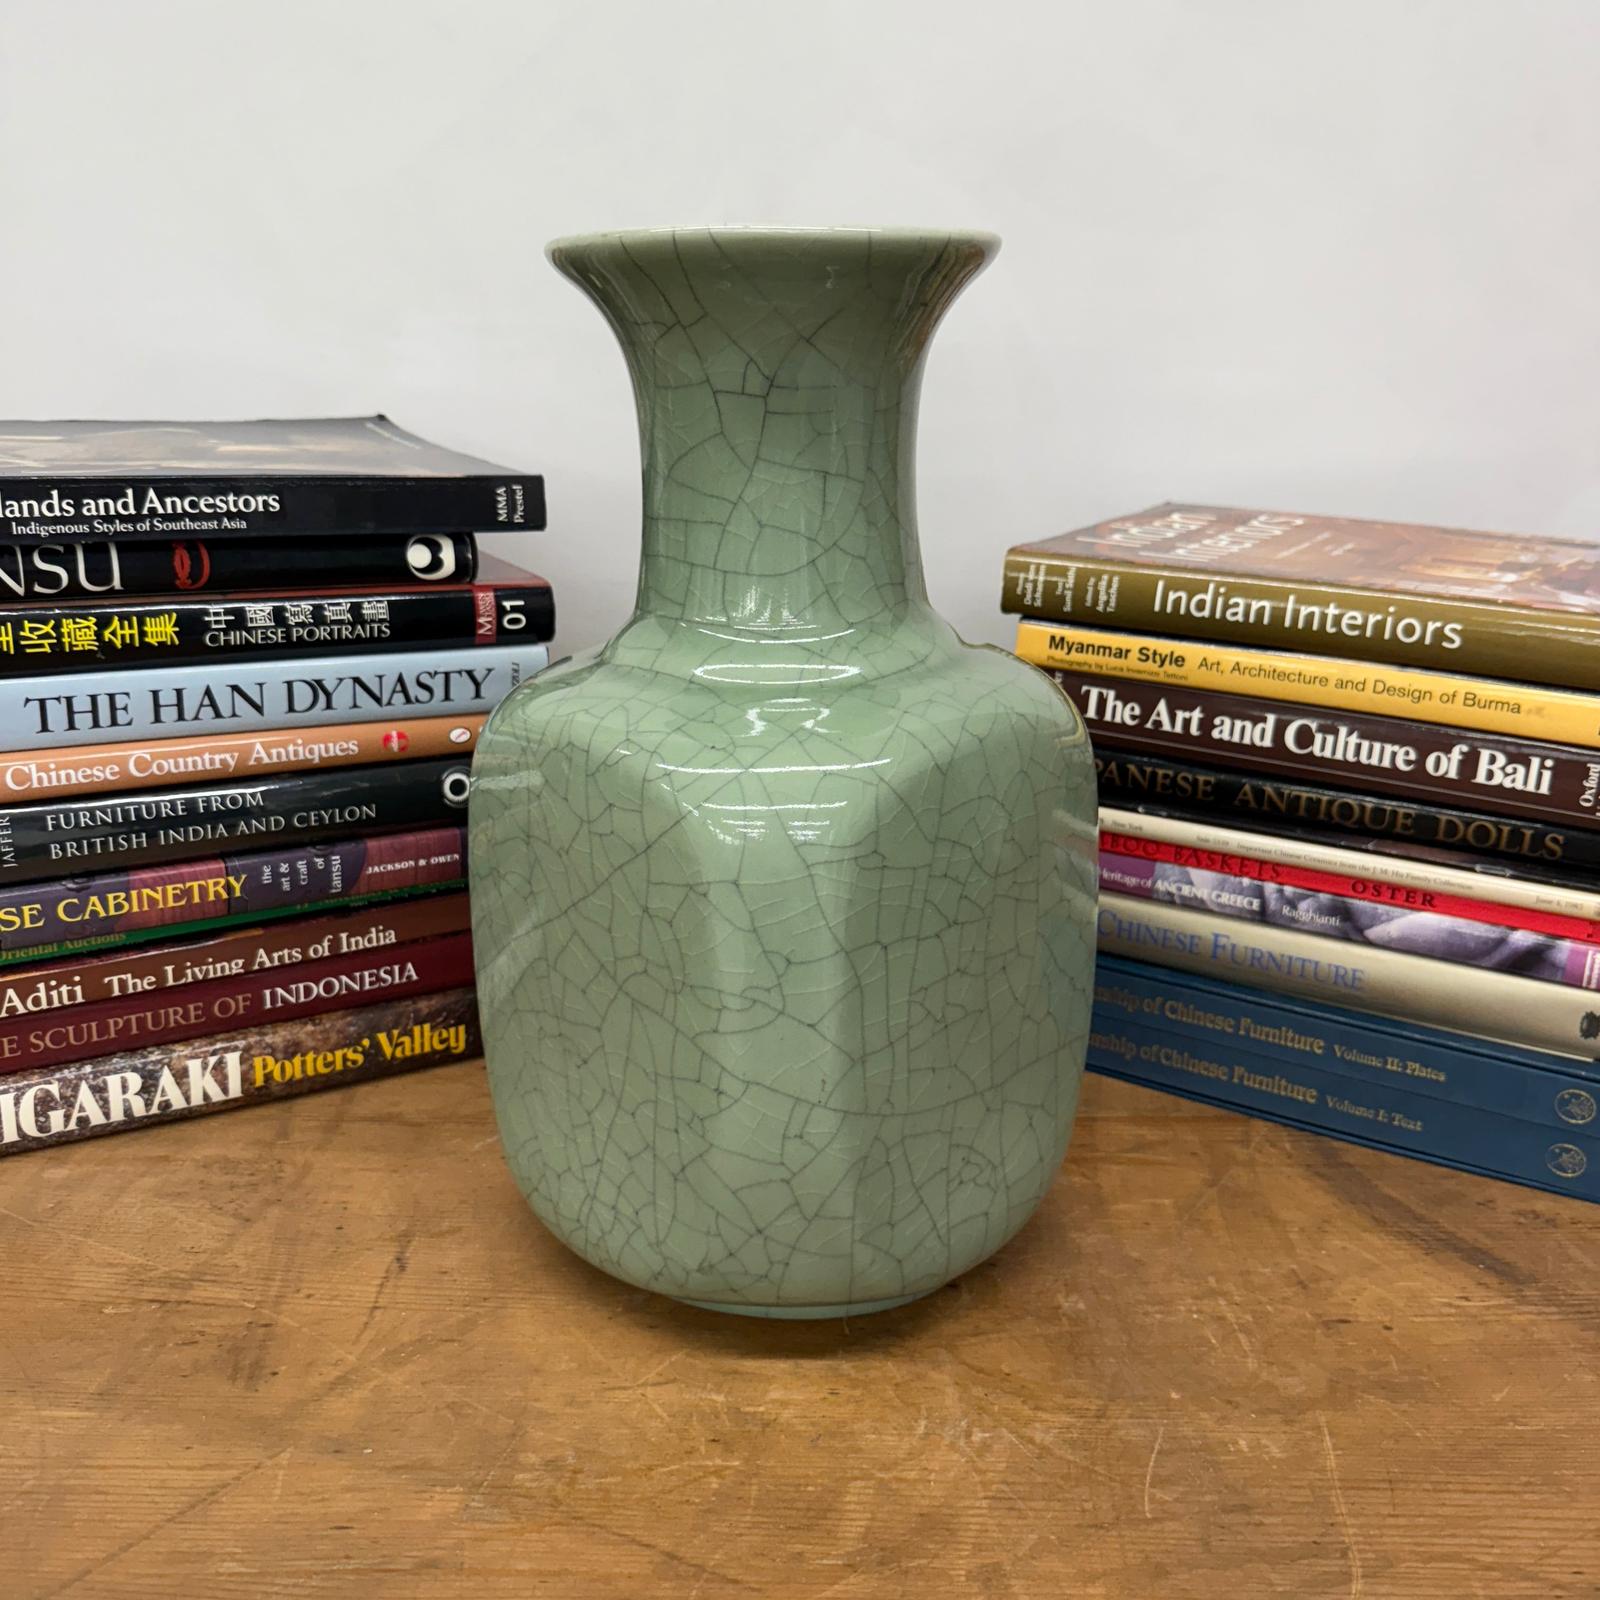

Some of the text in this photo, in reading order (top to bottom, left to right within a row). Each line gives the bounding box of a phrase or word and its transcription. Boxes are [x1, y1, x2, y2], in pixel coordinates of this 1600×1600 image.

[82, 488, 136, 515] and
[142, 487, 280, 514] Ancestors
[495, 487, 508, 522] MMA
[513, 484, 525, 523] Prestel
[12, 516, 247, 538] Indigenous Styles of Southeast Asia
[501, 600, 527, 630] 01
[1153, 579, 1464, 649] Indian Interiors
[204, 622, 391, 647] CHINESE PORTRAITS
[1049, 635, 1521, 715] Myanmar Style Art, Architecture and Design of Burma
[24, 668, 495, 734] THE HAN DYNASTY
[1081, 684, 1555, 796] The Art and Culture of Bali
[5, 763, 121, 791] Chinese
[128, 751, 239, 778] Country
[248, 738, 359, 766] Antiques
[46, 791, 265, 831] FURNITURE FROM
[1234, 782, 1417, 835] ANTIQUE
[1435, 813, 1565, 861] DOLLS
[0, 816, 18, 868] JAFFER
[50, 804, 377, 860] BRITISH INDIA AND CEYLON
[261, 864, 272, 884] the
[279, 862, 291, 892] art &
[297, 860, 308, 886] craft
[314, 857, 326, 870] of
[366, 853, 460, 875] JACKSON & OWEN
[1174, 845, 1281, 879] BASKETS
[0, 874, 248, 932] SE CABINETRY
[1099, 868, 1138, 888] eritage
[1211, 889, 1261, 911] GREECE
[1351, 879, 1436, 907] OSTER
[1281, 904, 1341, 927] Ragghianti
[63, 933, 127, 950] Auctions
[0, 925, 397, 1018] Aditi The Living Arts of India
[29, 1002, 206, 1053] SCULPTURE
[213, 993, 252, 1018] OF
[263, 961, 419, 1010] INDONESIA
[1143, 996, 1164, 1015] of
[1164, 1000, 1236, 1034] Chinese
[1238, 1017, 1325, 1055] Furniture
[1333, 1044, 1382, 1067] Volume
[1406, 1061, 1446, 1082] Plates
[0, 1023, 467, 1145] IGARAKI Potters’ Valley
[1140, 1044, 1160, 1062] of
[1160, 1047, 1229, 1081] Chinese
[1232, 1066, 1318, 1104] Furniture
[1325, 1095, 1374, 1120] Volume
[1392, 1112, 1423, 1132] Text
